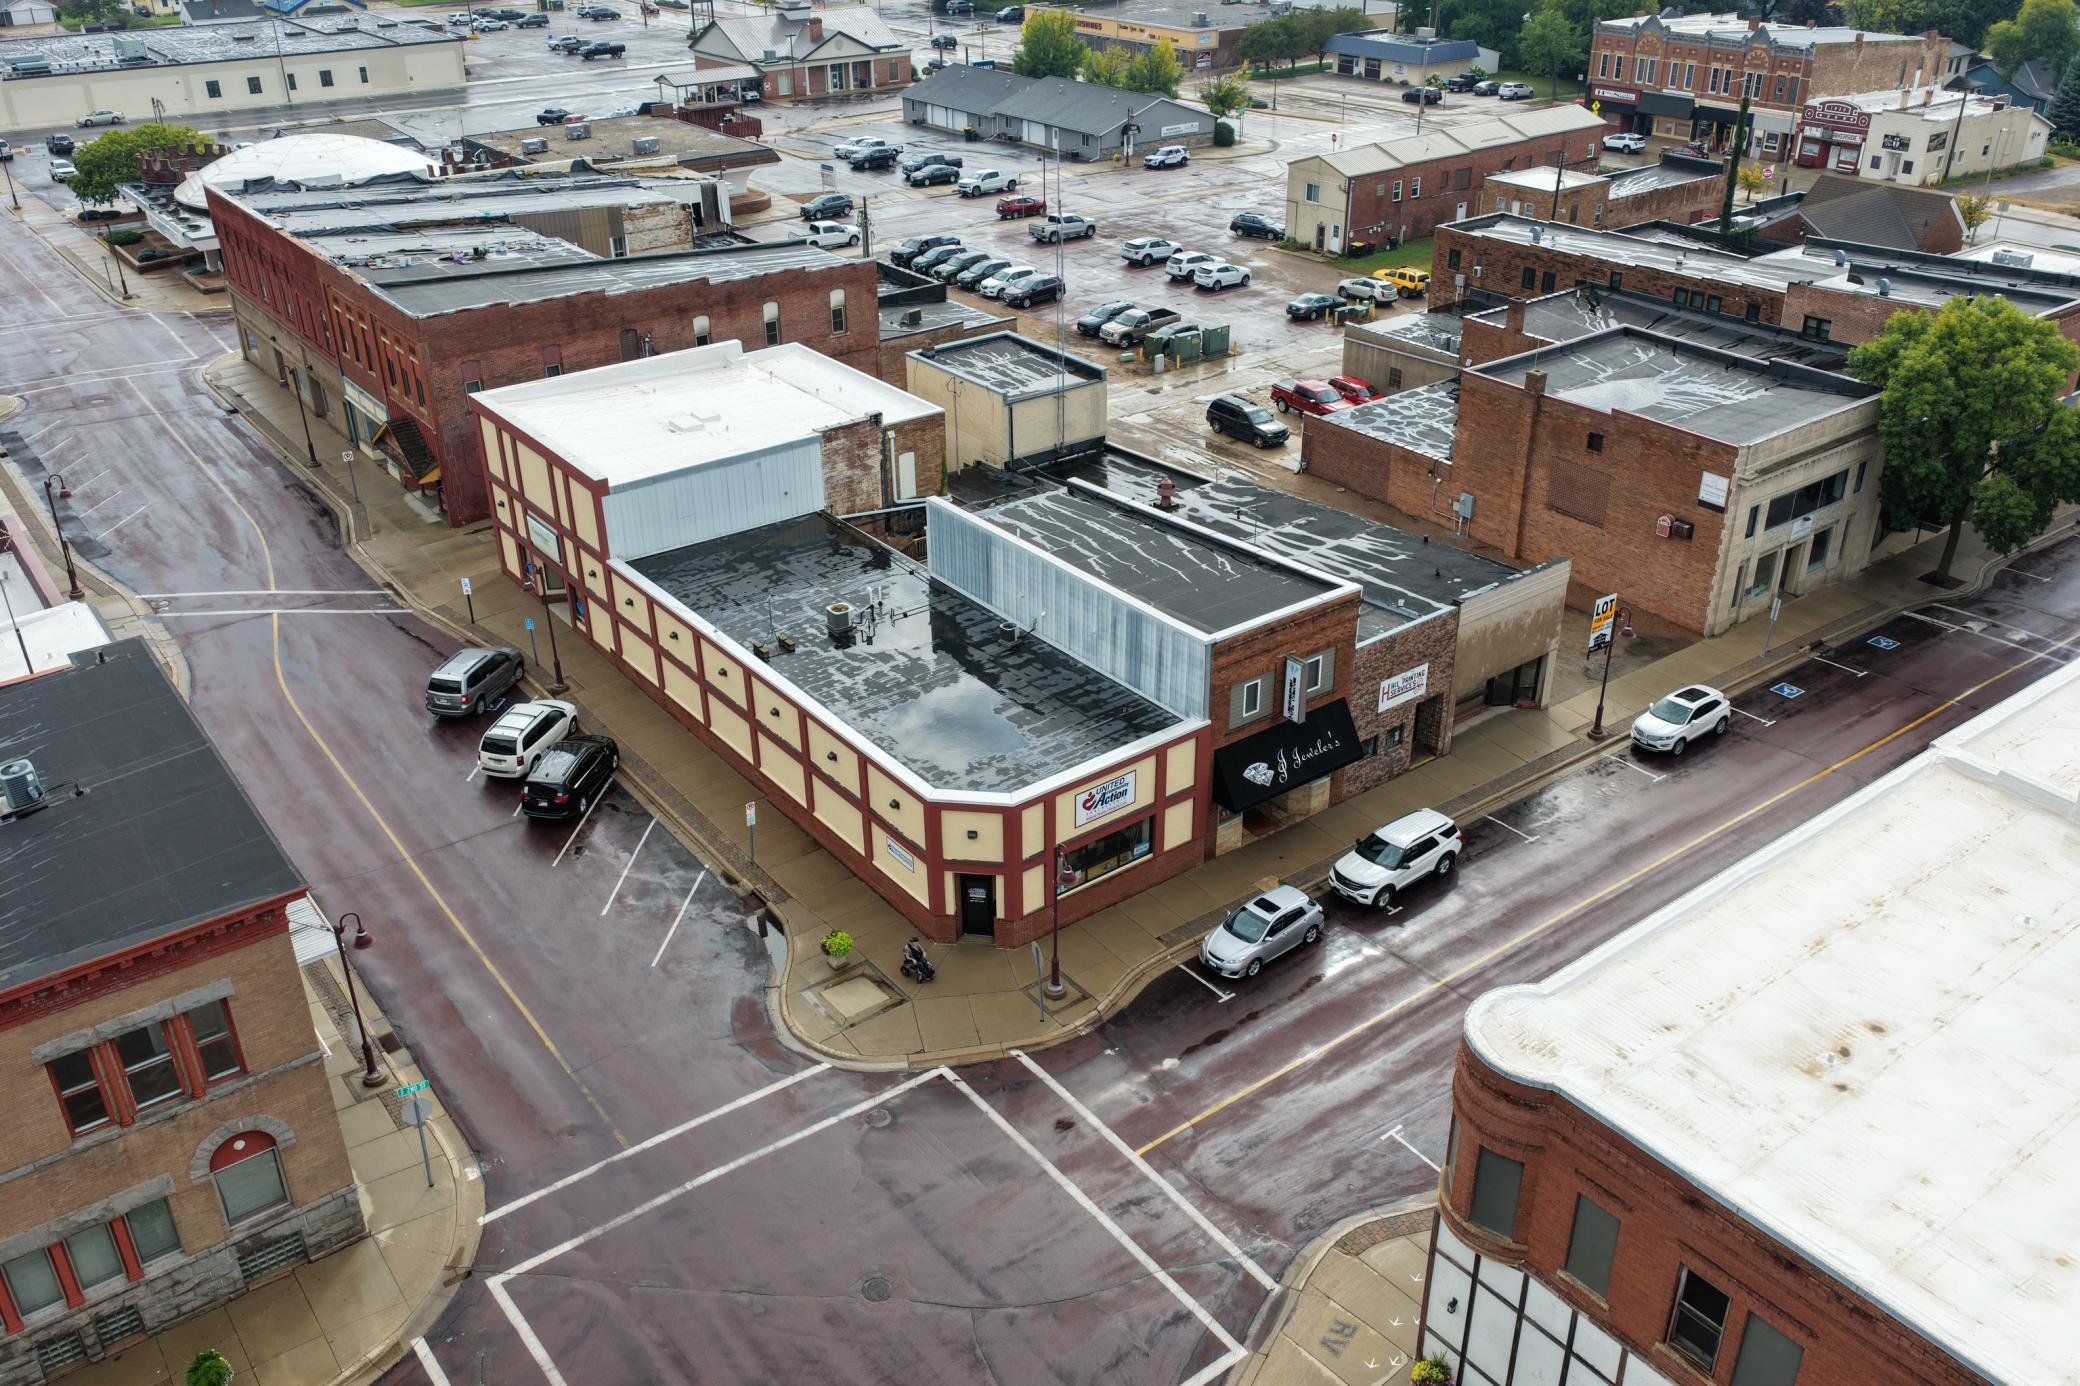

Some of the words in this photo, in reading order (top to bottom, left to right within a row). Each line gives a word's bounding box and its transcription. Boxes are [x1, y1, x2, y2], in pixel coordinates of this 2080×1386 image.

[1595, 598, 1616, 617] LOT
[1095, 777, 1126, 795] UNITED
[1092, 788, 1128, 810] Action
